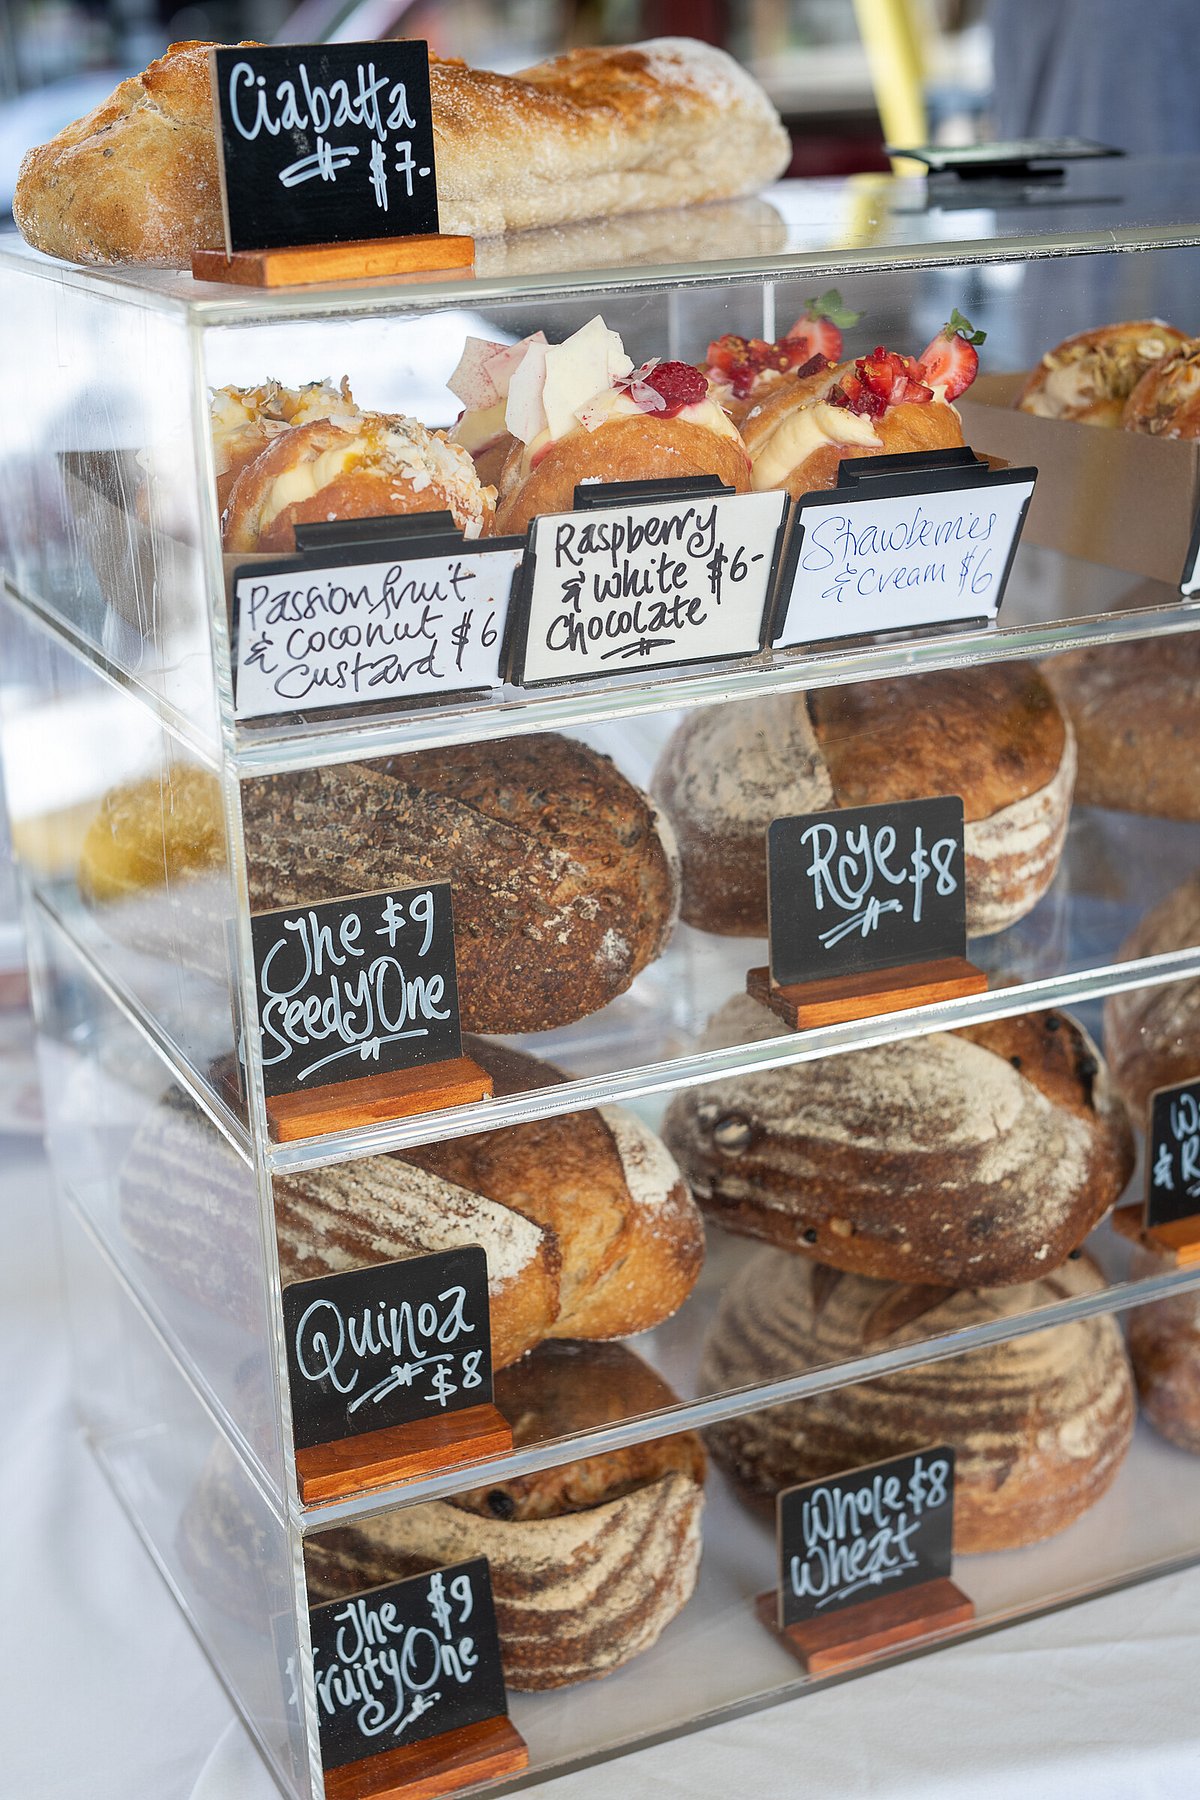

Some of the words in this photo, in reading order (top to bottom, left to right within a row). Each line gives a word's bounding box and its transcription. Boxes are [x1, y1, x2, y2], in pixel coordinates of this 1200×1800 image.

[230, 62, 416, 141] Ciabatta
[555, 504, 718, 568] Raspberry
[802, 507, 997, 571] Strawberries
[561, 571, 586, 613] &
[821, 563, 858, 602] &
[958, 545, 993, 598] $6
[244, 631, 278, 673] &
[546, 595, 708, 655] Chocolate
[800, 823, 907, 911] Rye
[908, 826, 958, 922] $8
[261, 911, 365, 998] The
[375, 891, 434, 956] $9
[296, 1285, 476, 1394] Quinoa
[424, 1349, 483, 1407] $8
[906, 1456, 949, 1516] $8
[334, 1599, 404, 1664] The
[426, 1572, 473, 1640] $9
